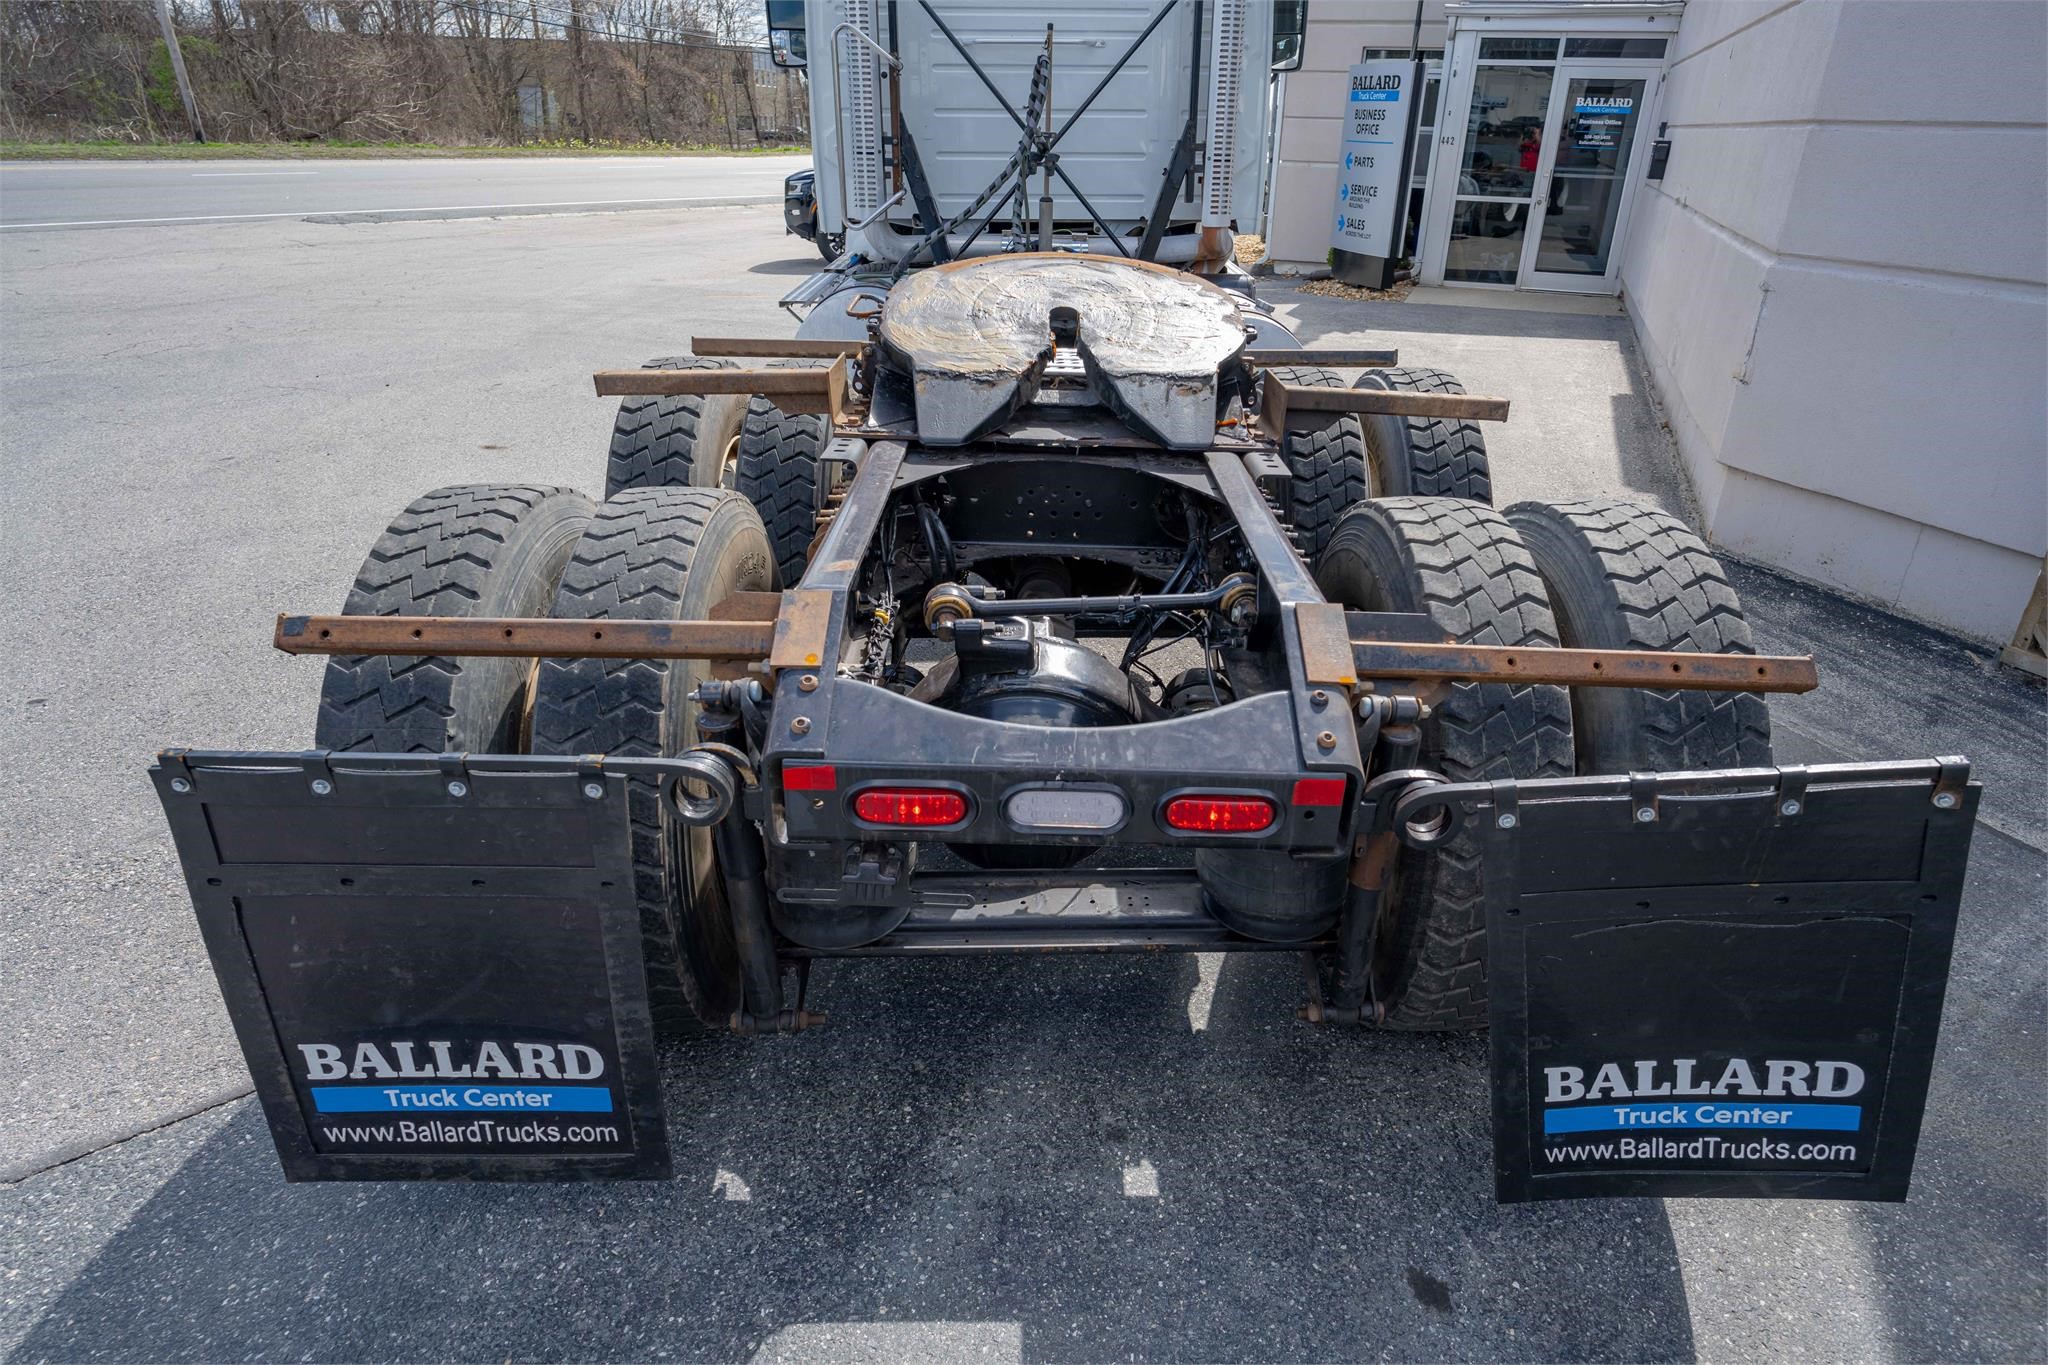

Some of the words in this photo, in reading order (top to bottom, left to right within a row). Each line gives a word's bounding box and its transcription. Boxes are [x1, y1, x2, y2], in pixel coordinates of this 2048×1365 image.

[1352, 74, 1401, 90] BALLARD
[1370, 92, 1387, 100] Center
[1576, 97, 1633, 108] BALLARD
[1354, 109, 1386, 120] BUSINESS
[1356, 123, 1380, 135] OFFICE
[1354, 156, 1375, 168] PARTS
[1350, 184, 1378, 197] SERVICE
[1346, 218, 1366, 231] SALES
[297, 1041, 605, 1080] BALLARD
[1544, 1058, 1866, 1103] BALLARD
[384, 1088, 459, 1107] Truck
[463, 1089, 552, 1107] Center
[1614, 1106, 1688, 1125] Truck
[1695, 1106, 1793, 1125] Center
[323, 1120, 619, 1144] www.BallardTrucks.com
[1545, 1137, 1856, 1164] www.BallardTrucks.com
